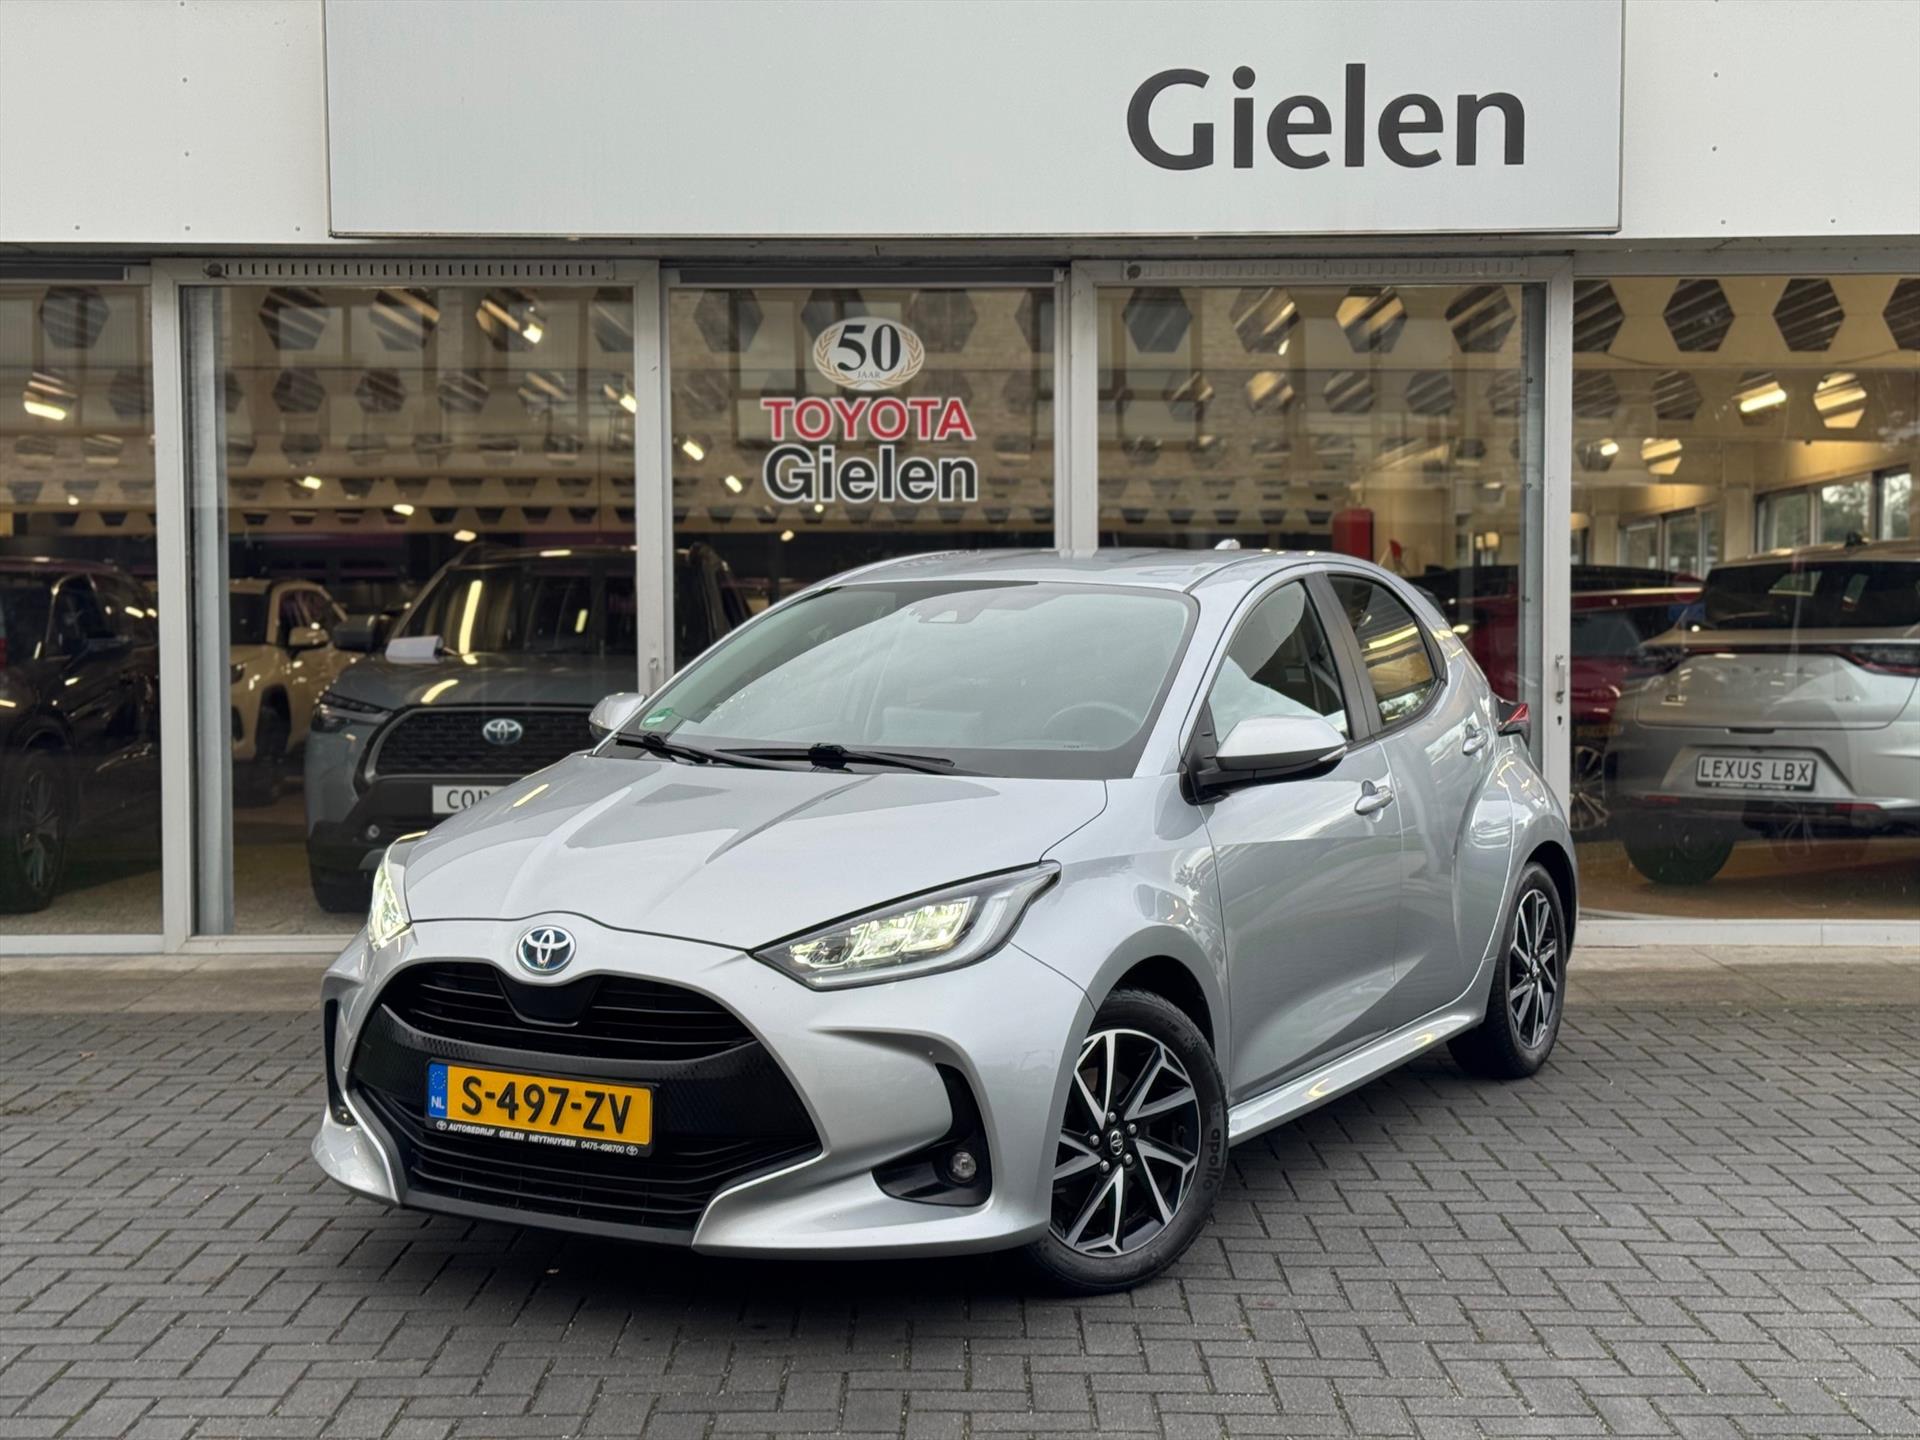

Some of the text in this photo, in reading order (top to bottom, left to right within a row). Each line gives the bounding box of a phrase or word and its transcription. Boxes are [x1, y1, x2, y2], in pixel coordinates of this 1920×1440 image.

[1127, 63, 1525, 171] Gielen
[837, 323, 901, 372] 50
[857, 370, 881, 379] JAAR
[761, 398, 976, 441] TOYOTA
[764, 445, 977, 502] Gielen
[1701, 759, 1810, 782] LEXUS LBX
[431, 1095, 446, 1110] NL
[461, 1075, 632, 1134] S-497-ZV
[448, 1123, 495, 1136] AUTOBEDRIJF
[499, 1130, 525, 1141] GIELEN
[528, 1134, 577, 1148] HEYTHUYSEN
